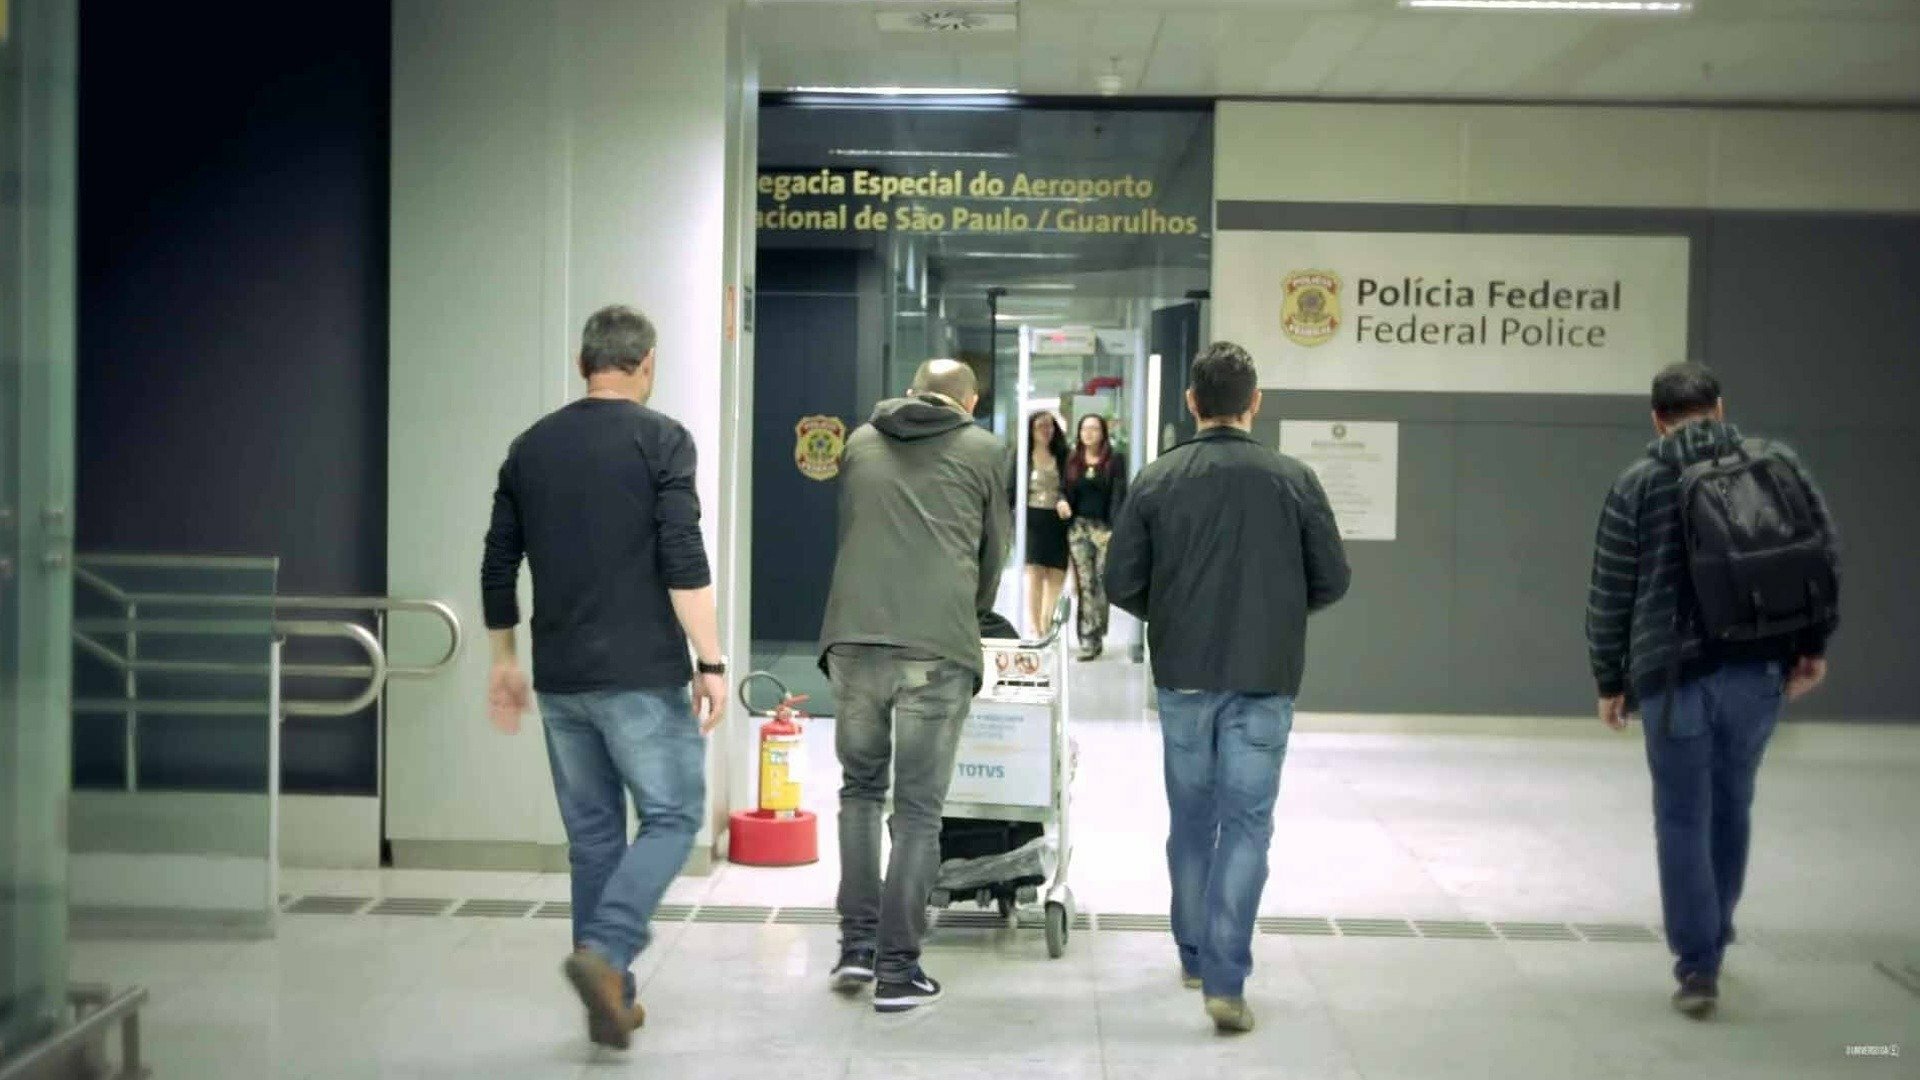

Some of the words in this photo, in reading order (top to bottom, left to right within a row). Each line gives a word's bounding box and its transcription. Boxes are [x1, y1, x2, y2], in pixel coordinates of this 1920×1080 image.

[852, 170, 962, 202] Especial
[969, 171, 1004, 197] do
[1011, 173, 1153, 204] Aeroporto
[854, 204, 888, 230] de
[895, 206, 945, 232] São
[952, 207, 1028, 232] Paulo
[1056, 208, 1198, 235] Guarulhos
[1357, 276, 1475, 308] Polícia
[1488, 279, 1622, 311] Federal
[1356, 315, 1487, 345] Federal
[1501, 317, 1606, 347] Police
[957, 762, 1006, 779] TOTVS
